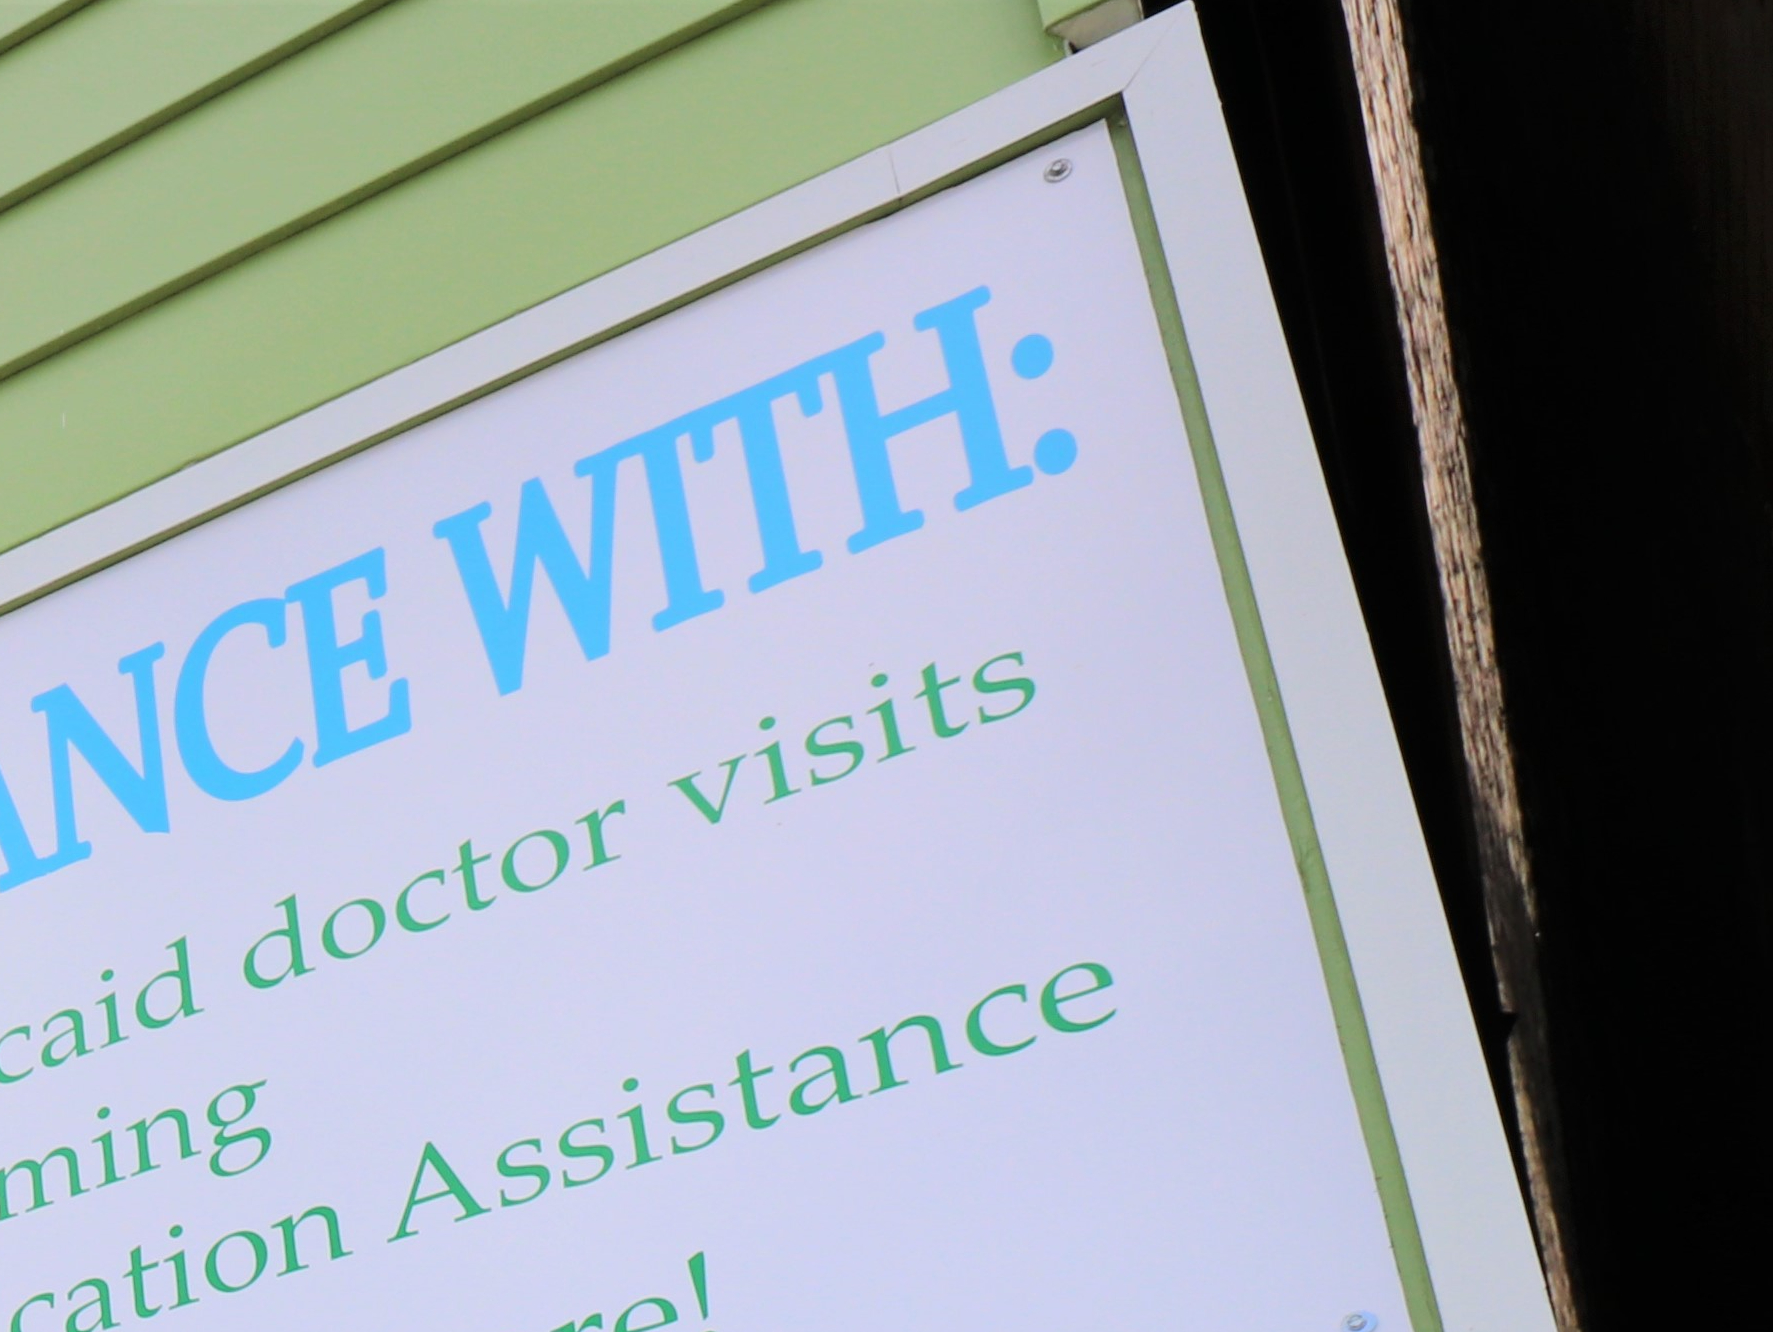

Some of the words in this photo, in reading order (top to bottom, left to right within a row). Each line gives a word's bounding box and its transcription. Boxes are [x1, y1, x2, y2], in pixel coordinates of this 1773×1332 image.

[432, 284, 1078, 697] WITH:
[241, 797, 629, 990] doctor
[666, 649, 1039, 825] visits
[386, 961, 1120, 1243] Assistance
